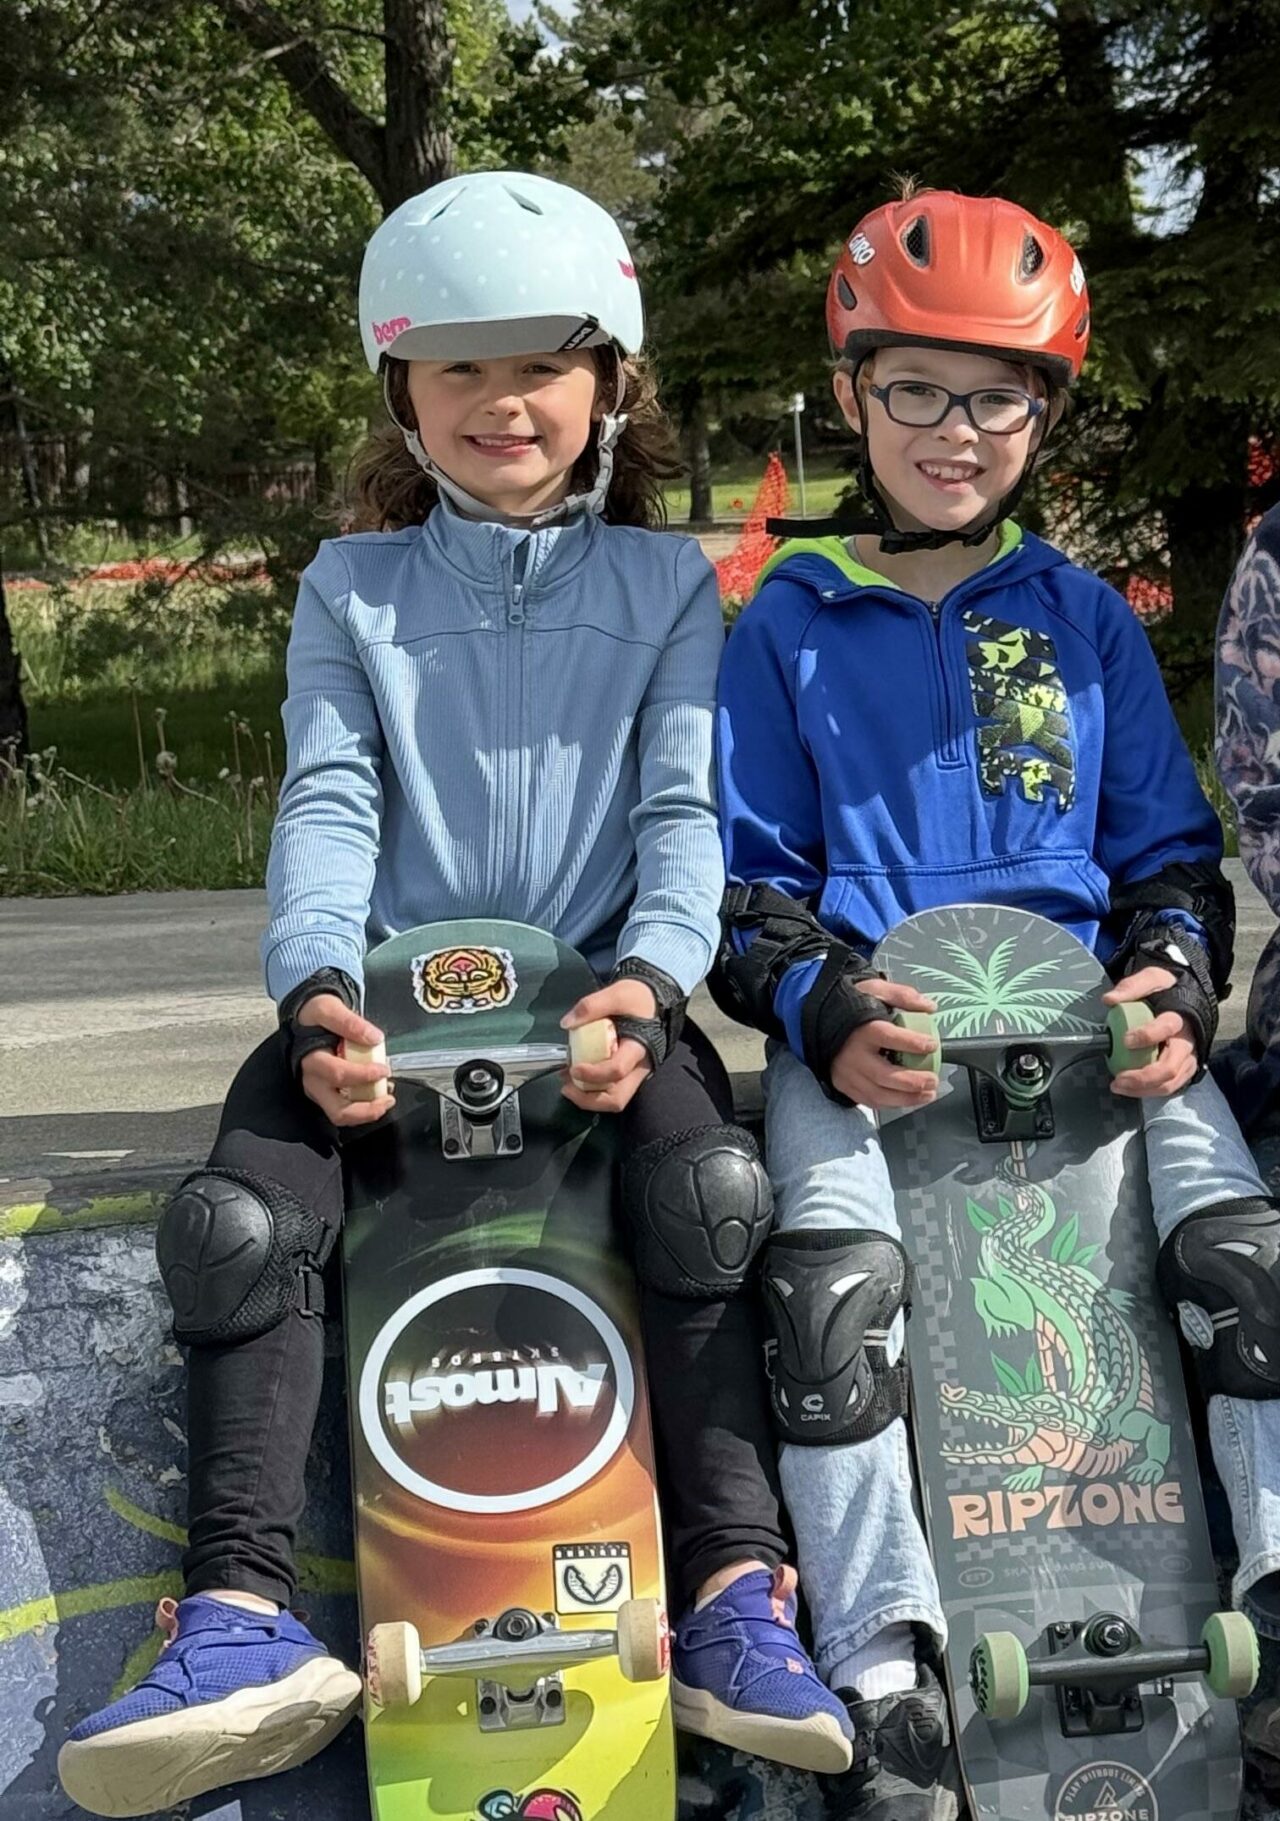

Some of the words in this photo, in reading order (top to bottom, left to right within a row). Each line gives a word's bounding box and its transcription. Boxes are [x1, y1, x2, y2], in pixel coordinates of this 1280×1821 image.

[431, 1346, 560, 1369] SKTBRDS
[384, 1362, 608, 1424] Almost
[948, 1481, 1186, 1541] RIPZONE
[1065, 1782, 1082, 1803] PLAY
[1080, 1767, 1119, 1784] WITHOUT
